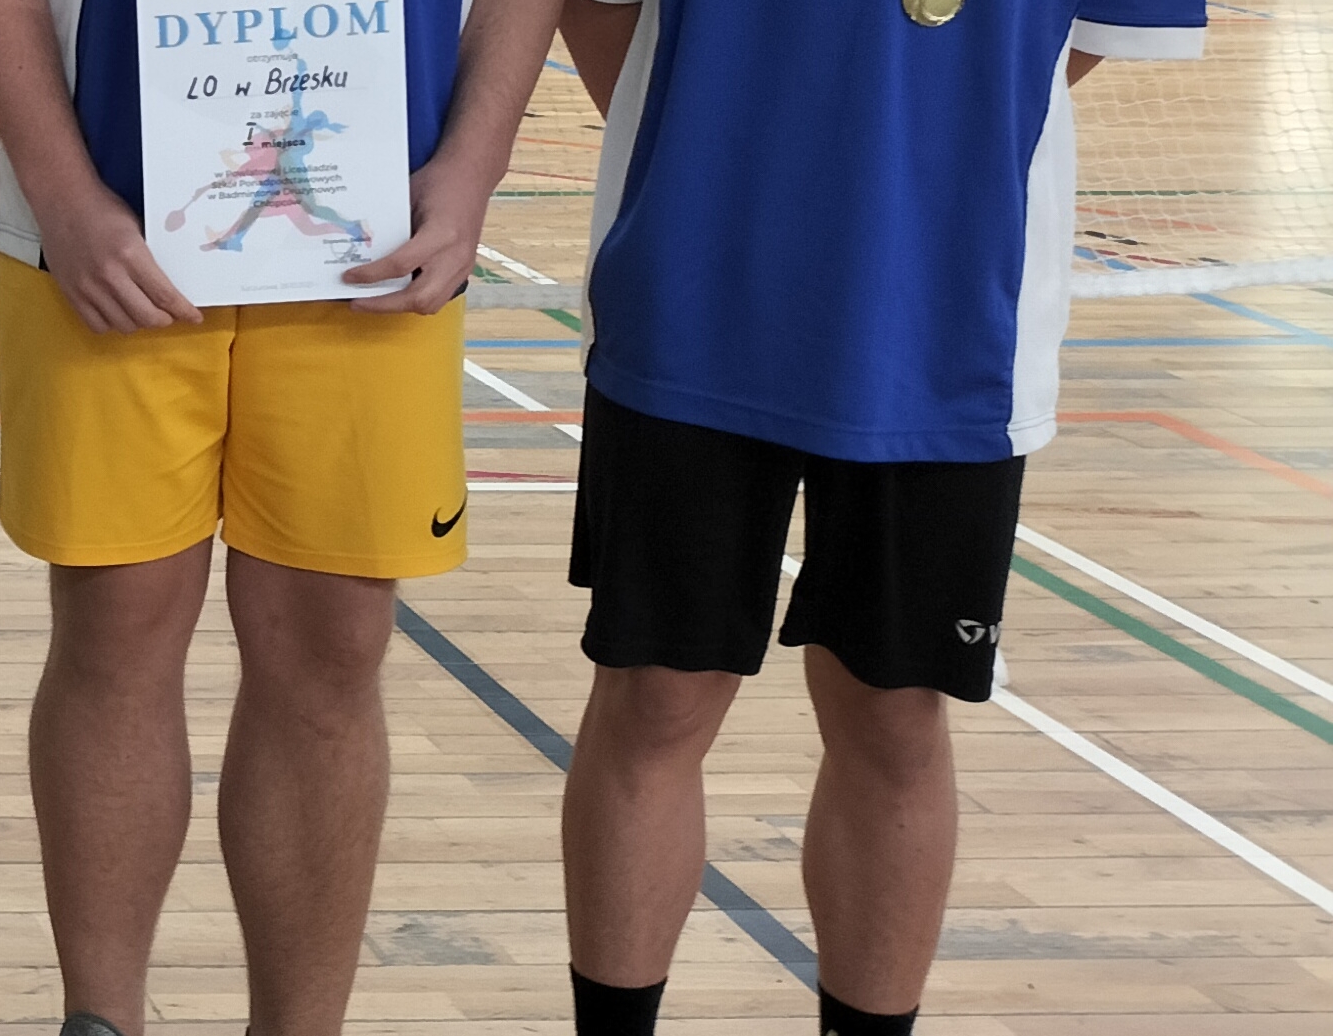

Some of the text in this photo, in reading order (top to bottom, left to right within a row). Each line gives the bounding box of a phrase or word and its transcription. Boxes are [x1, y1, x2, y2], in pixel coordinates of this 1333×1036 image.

[153, 0, 390, 49] DYPLOM
[246, 52, 298, 64] otrzymuje
[186, 65, 349, 100] LO w Brzesku
[250, 111, 262, 119] za
[261, 138, 306, 150] miejsca
